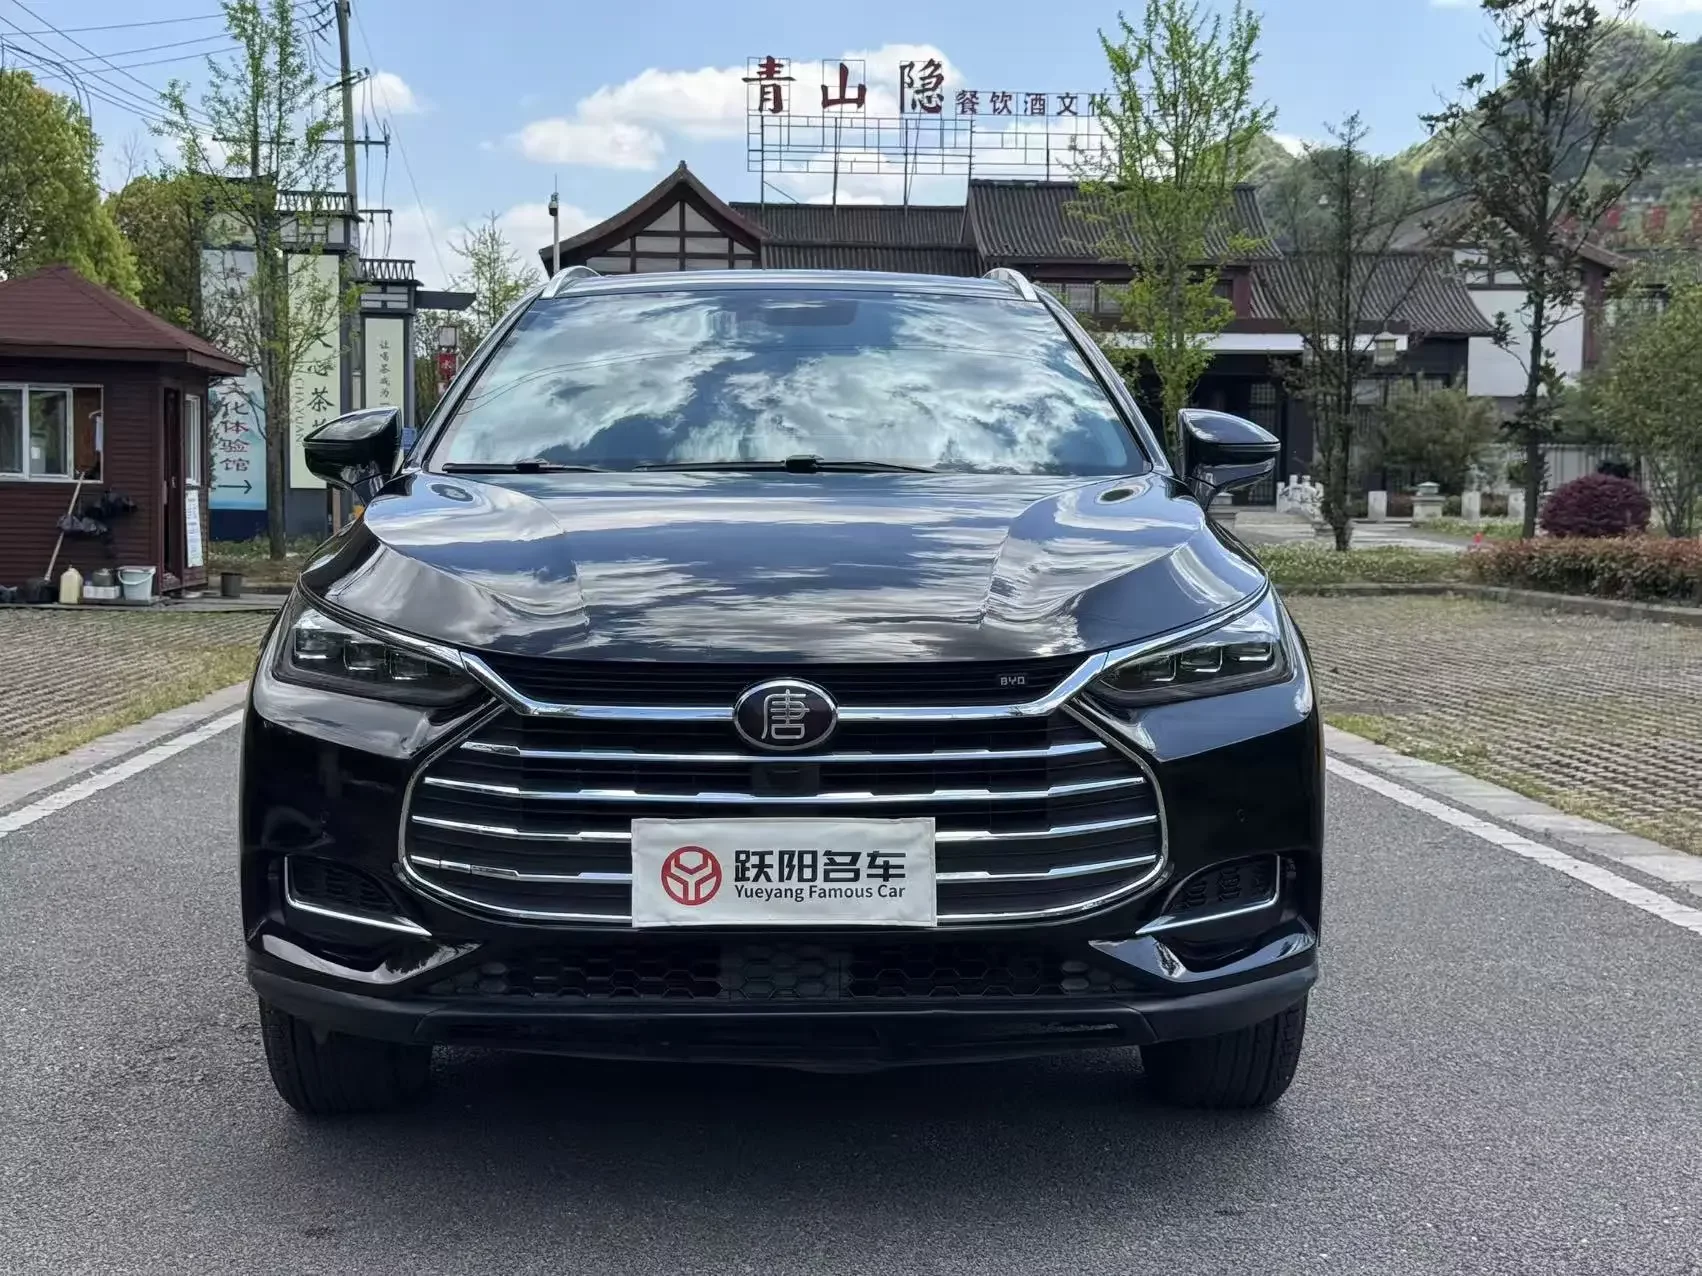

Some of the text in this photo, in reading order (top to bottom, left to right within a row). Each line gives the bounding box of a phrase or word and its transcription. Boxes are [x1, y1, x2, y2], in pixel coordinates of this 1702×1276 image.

[741, 55, 945, 114] 青山隐
[1000, 676, 1025, 686] BYD
[761, 688, 810, 740] 唐
[734, 850, 906, 882] 跃阳名车
[734, 884, 906, 902] Yueyang Famous Car
